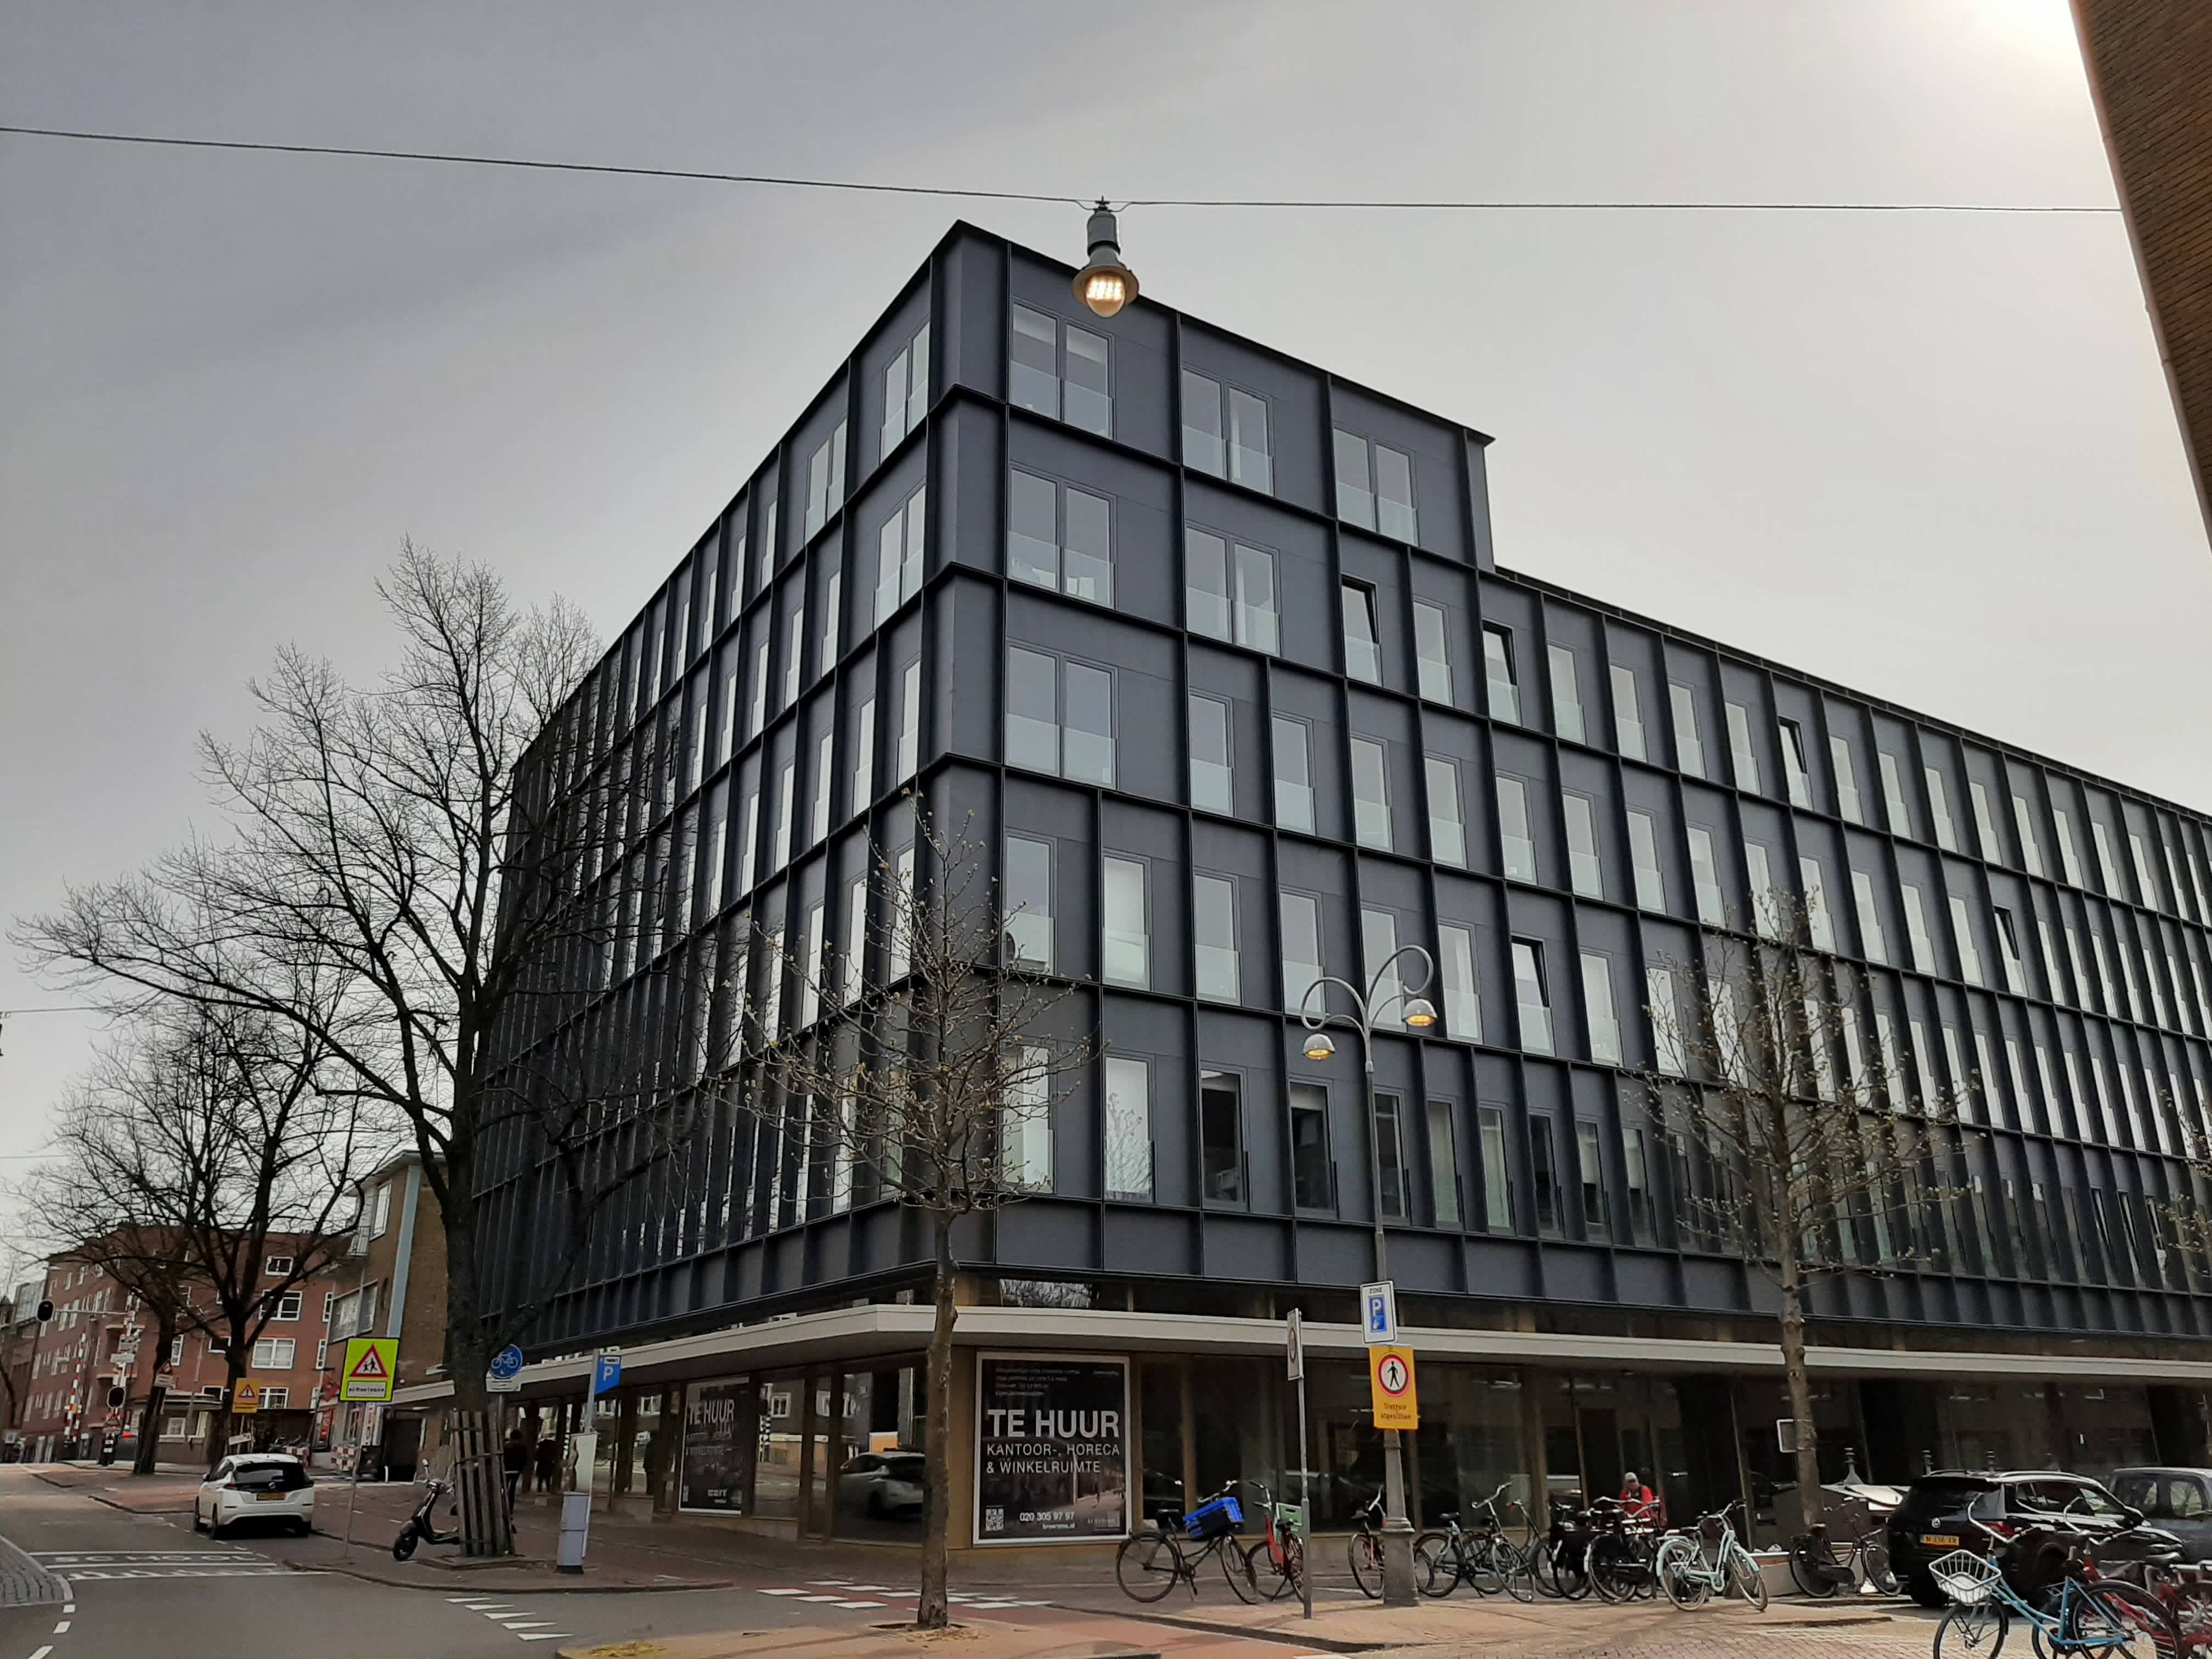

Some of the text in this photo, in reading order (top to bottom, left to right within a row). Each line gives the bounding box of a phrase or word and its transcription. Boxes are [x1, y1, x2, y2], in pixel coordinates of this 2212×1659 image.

[1372, 1299, 1381, 1317] P
[604, 1366, 613, 1380] P
[689, 1399, 735, 1425] TE HUUR
[988, 1409, 1120, 1438] TE HUUR
[986, 1443, 1120, 1457] KANTOOR-, HORECA
[986, 1461, 1101, 1474] & WINKELRUIMTE
[1020, 1511, 1075, 1522] 020 305 97 97
